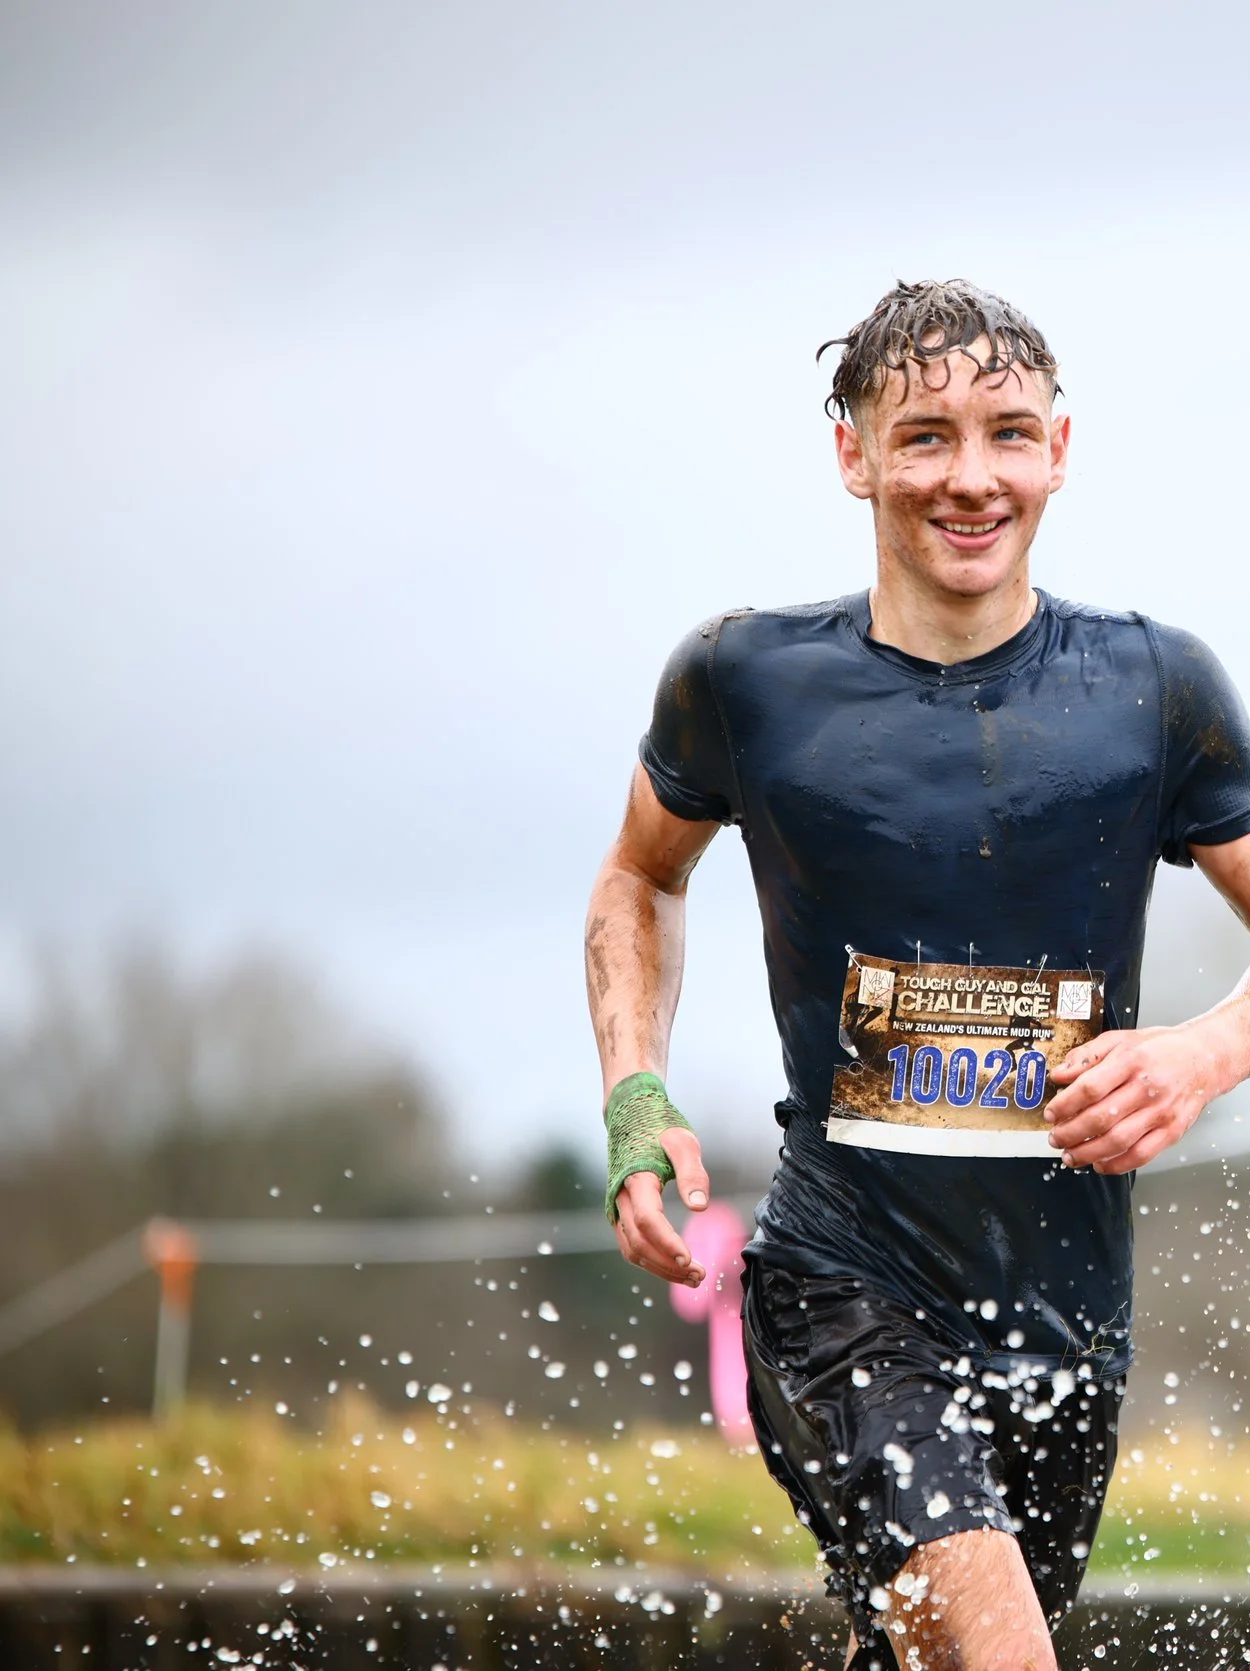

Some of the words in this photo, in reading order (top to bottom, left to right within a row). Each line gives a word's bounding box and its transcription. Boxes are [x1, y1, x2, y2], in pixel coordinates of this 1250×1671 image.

[900, 976, 951, 991] TOUGH
[954, 978, 986, 992] GUY
[986, 980, 1018, 994] AND
[1020, 982, 1051, 996] GAL
[897, 991, 1051, 1018] CHALLENGE
[892, 1020, 913, 1032] NEW
[915, 1022, 964, 1035] ZEALAND'S
[966, 1025, 1008, 1037] ULTIMATE
[1010, 1027, 1031, 1038] MUD
[1032, 1028, 1051, 1039] RUN
[887, 1044, 1047, 1110] 10020
